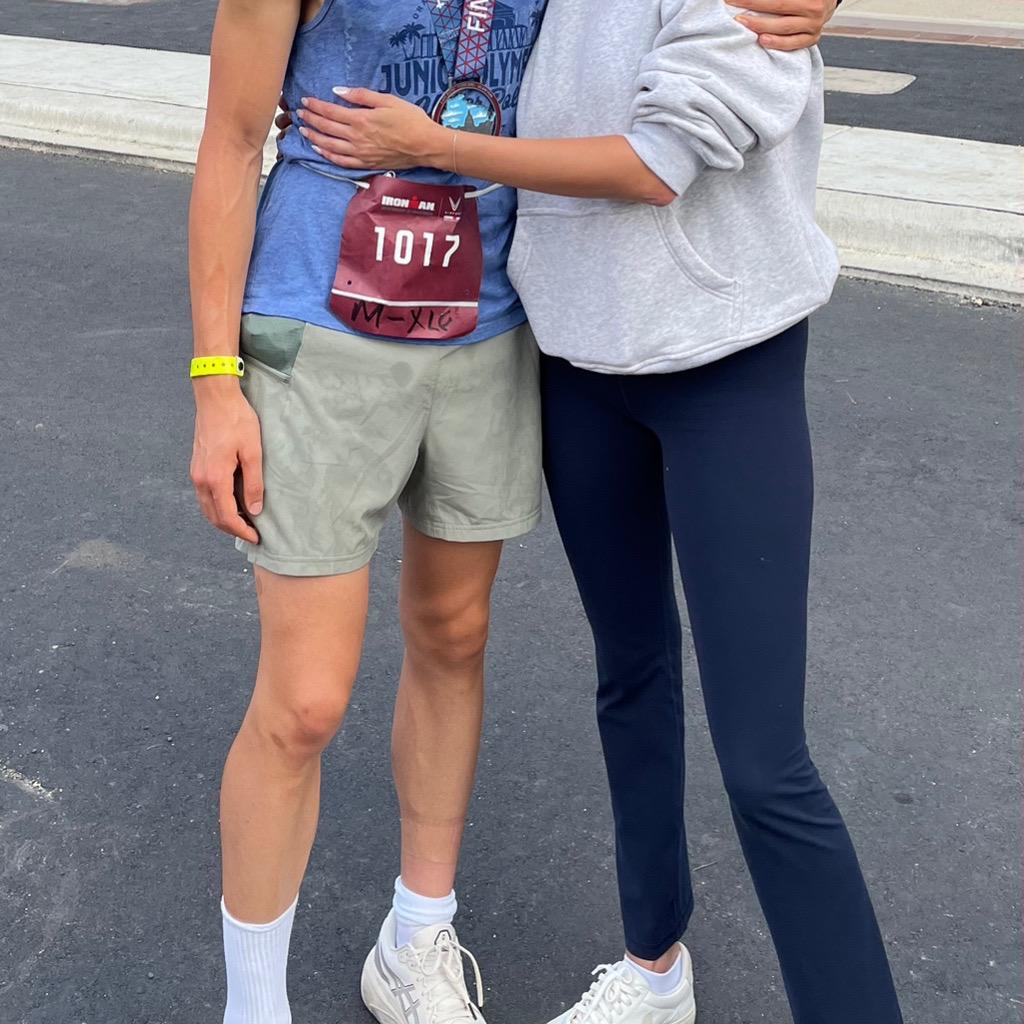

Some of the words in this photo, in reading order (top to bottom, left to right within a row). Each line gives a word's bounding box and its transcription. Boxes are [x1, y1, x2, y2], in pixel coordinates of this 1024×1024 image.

[380, 56, 449, 95] JUNIO
[381, 195, 435, 211] IRONMAN
[374, 226, 460, 268] 1017
